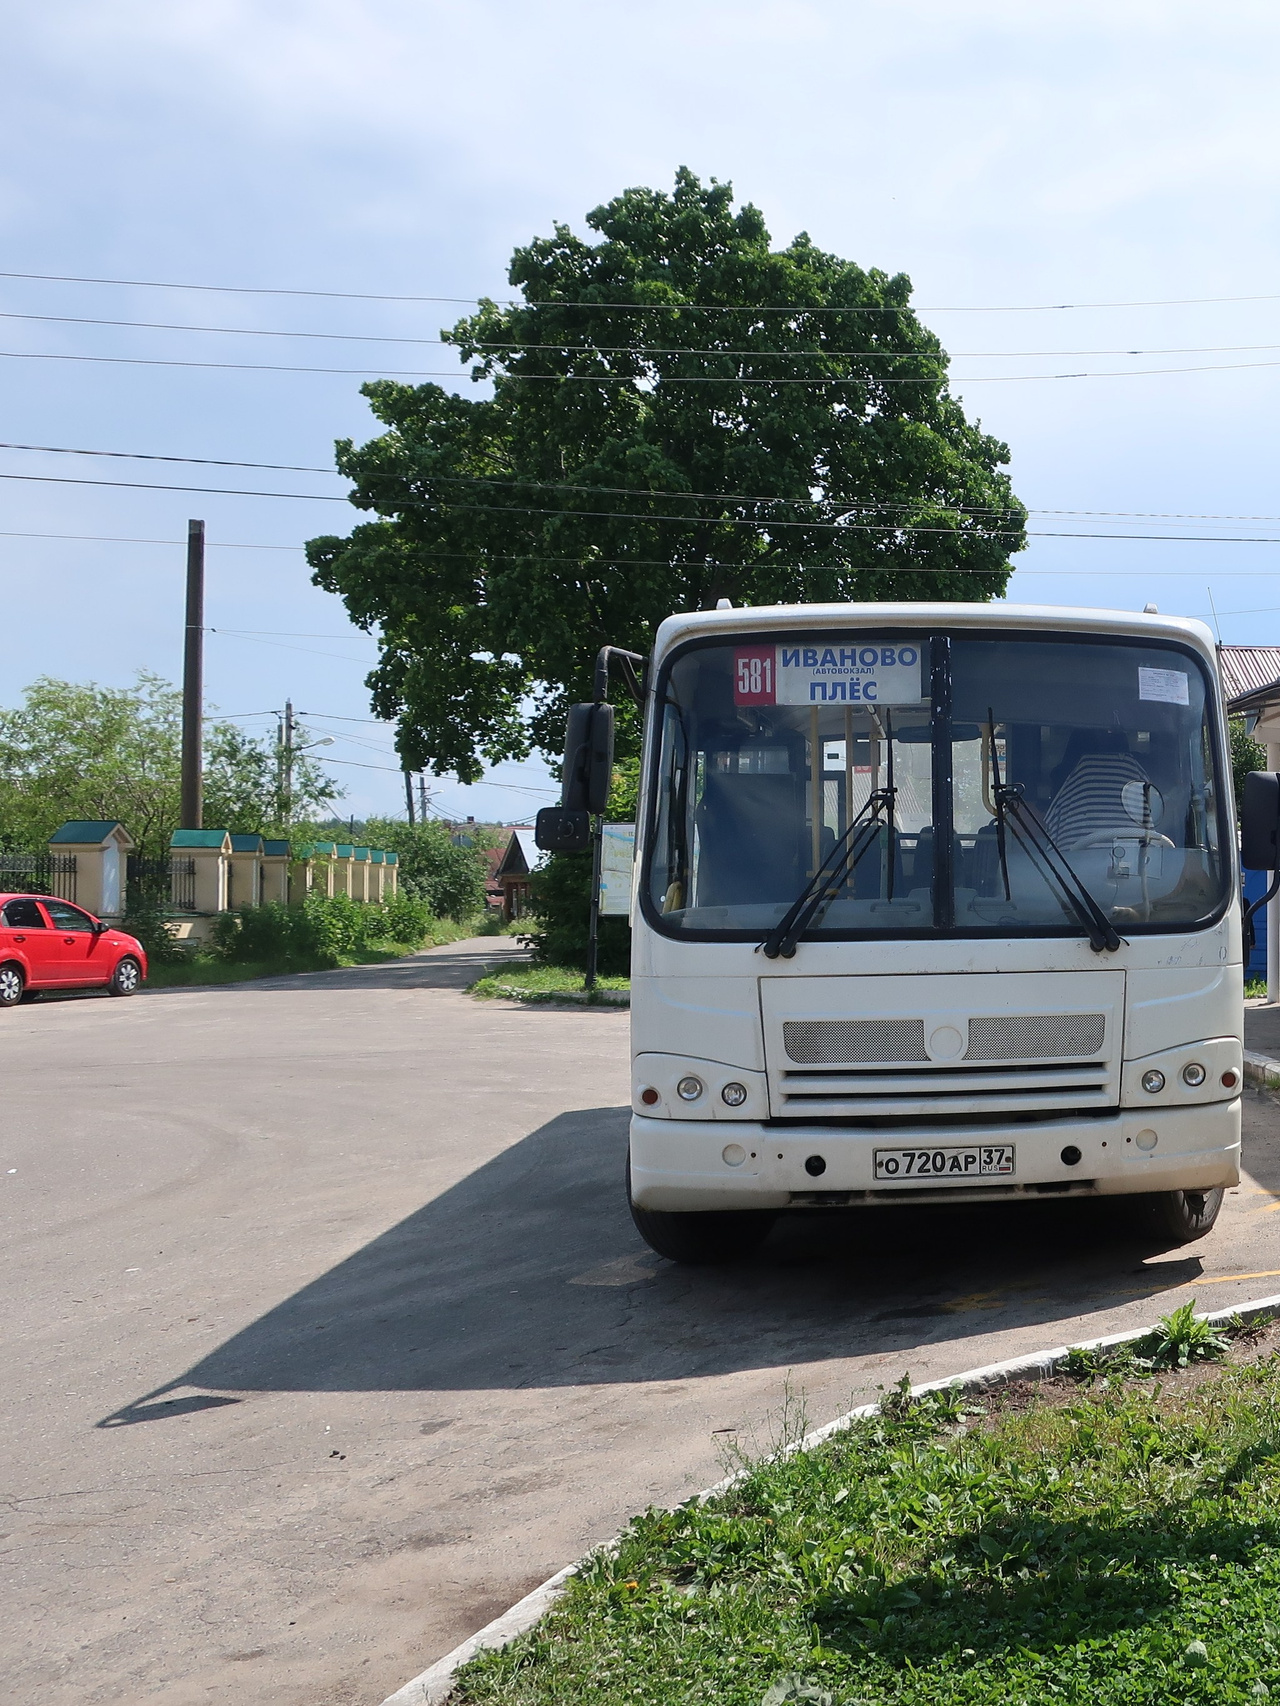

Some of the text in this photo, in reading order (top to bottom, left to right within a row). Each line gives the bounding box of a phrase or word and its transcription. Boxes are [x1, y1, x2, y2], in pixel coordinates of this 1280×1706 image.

[782, 647, 918, 667] ИВАНОВО
[738, 658, 771, 693] 581
[812, 667, 875, 676] (АВТОВОКЗАЛ)
[809, 677, 877, 700] ПЛЁС
[982, 1148, 1005, 1165] 37
